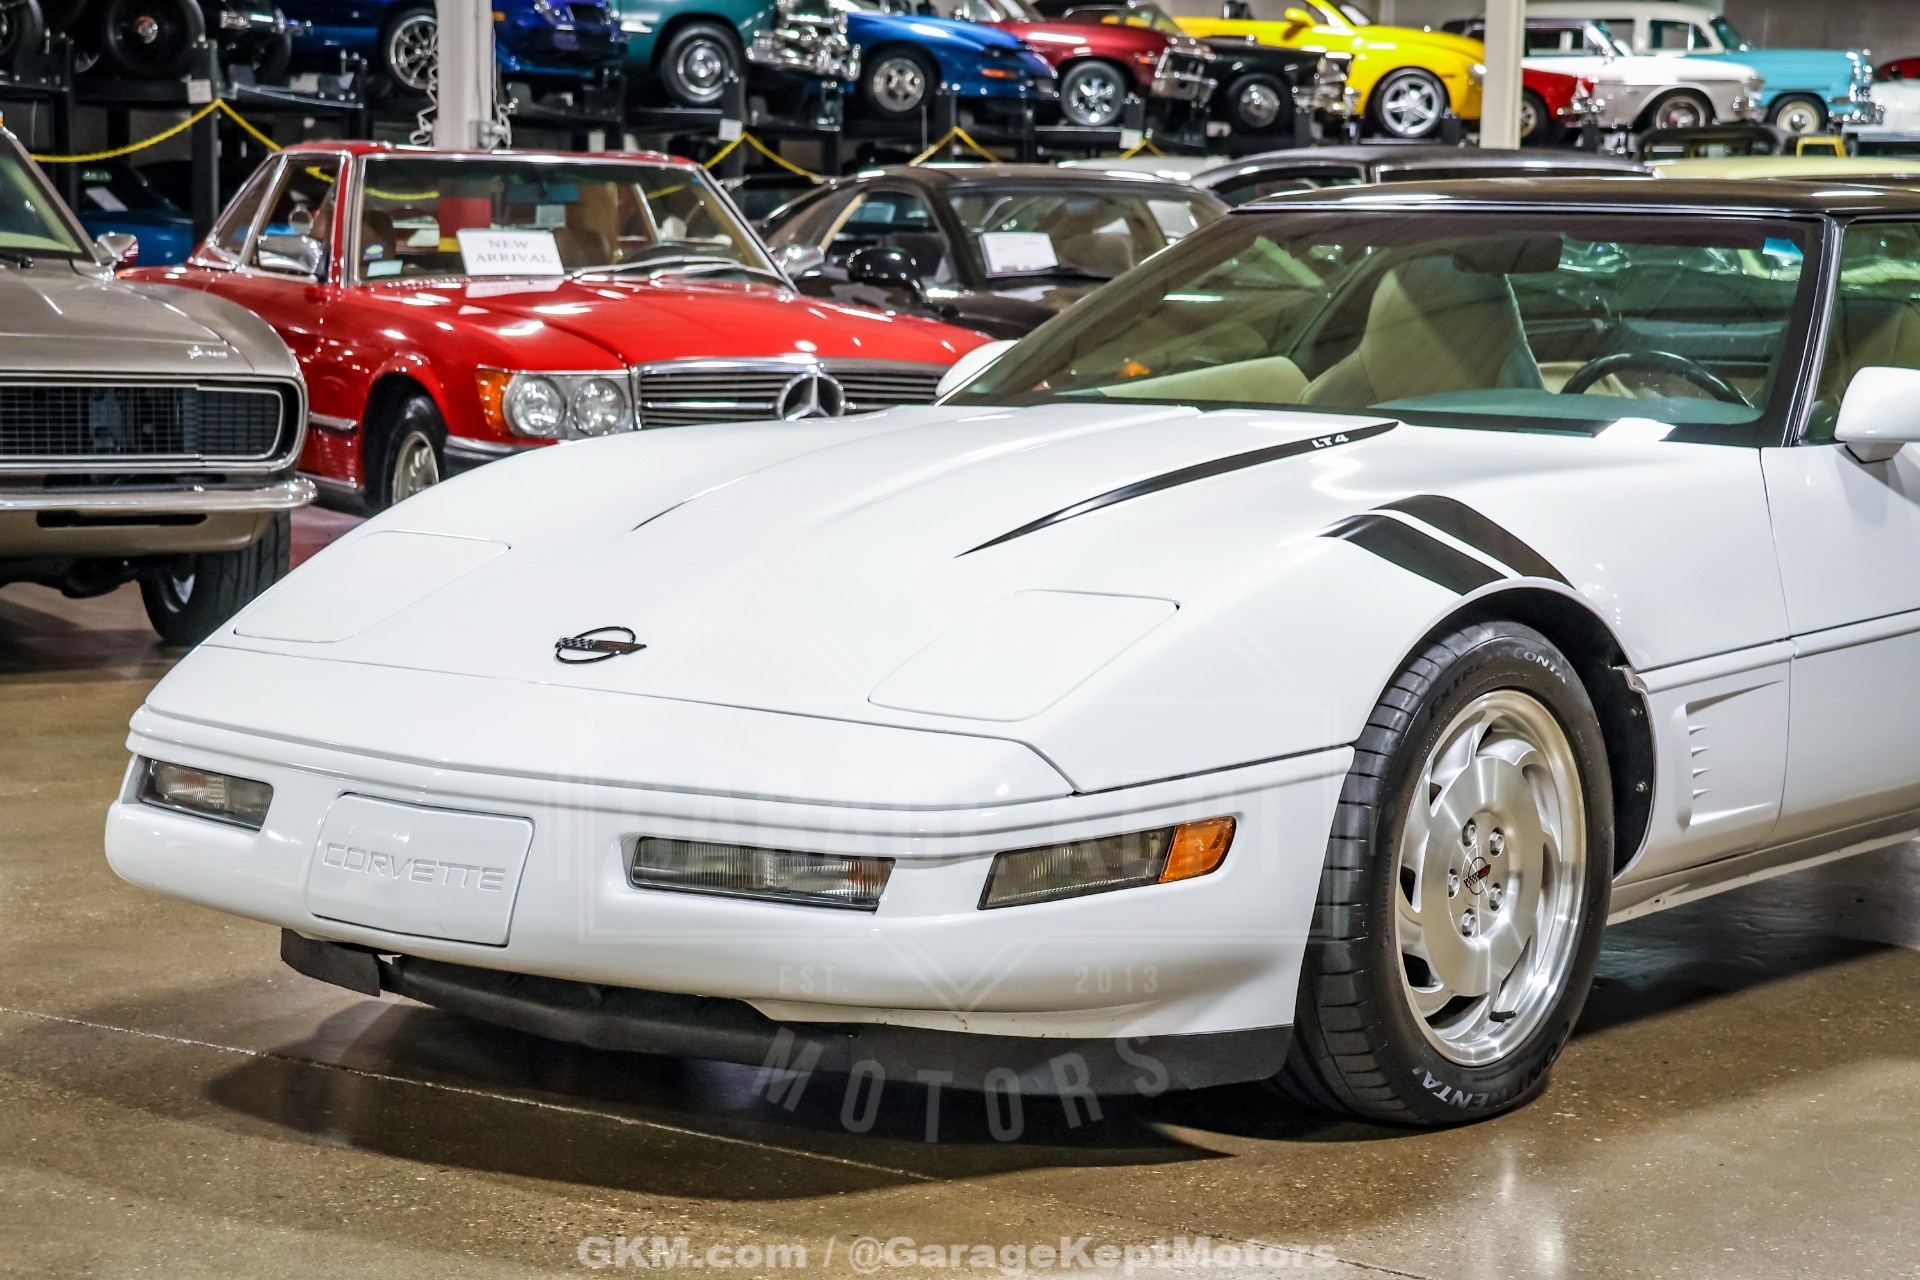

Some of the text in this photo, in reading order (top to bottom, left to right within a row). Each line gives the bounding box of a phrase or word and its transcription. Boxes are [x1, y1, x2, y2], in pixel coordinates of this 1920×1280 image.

[488, 239, 528, 250] NEW
[475, 253, 552, 264] ARRIVAL
[323, 842, 506, 892] CORVETTE
